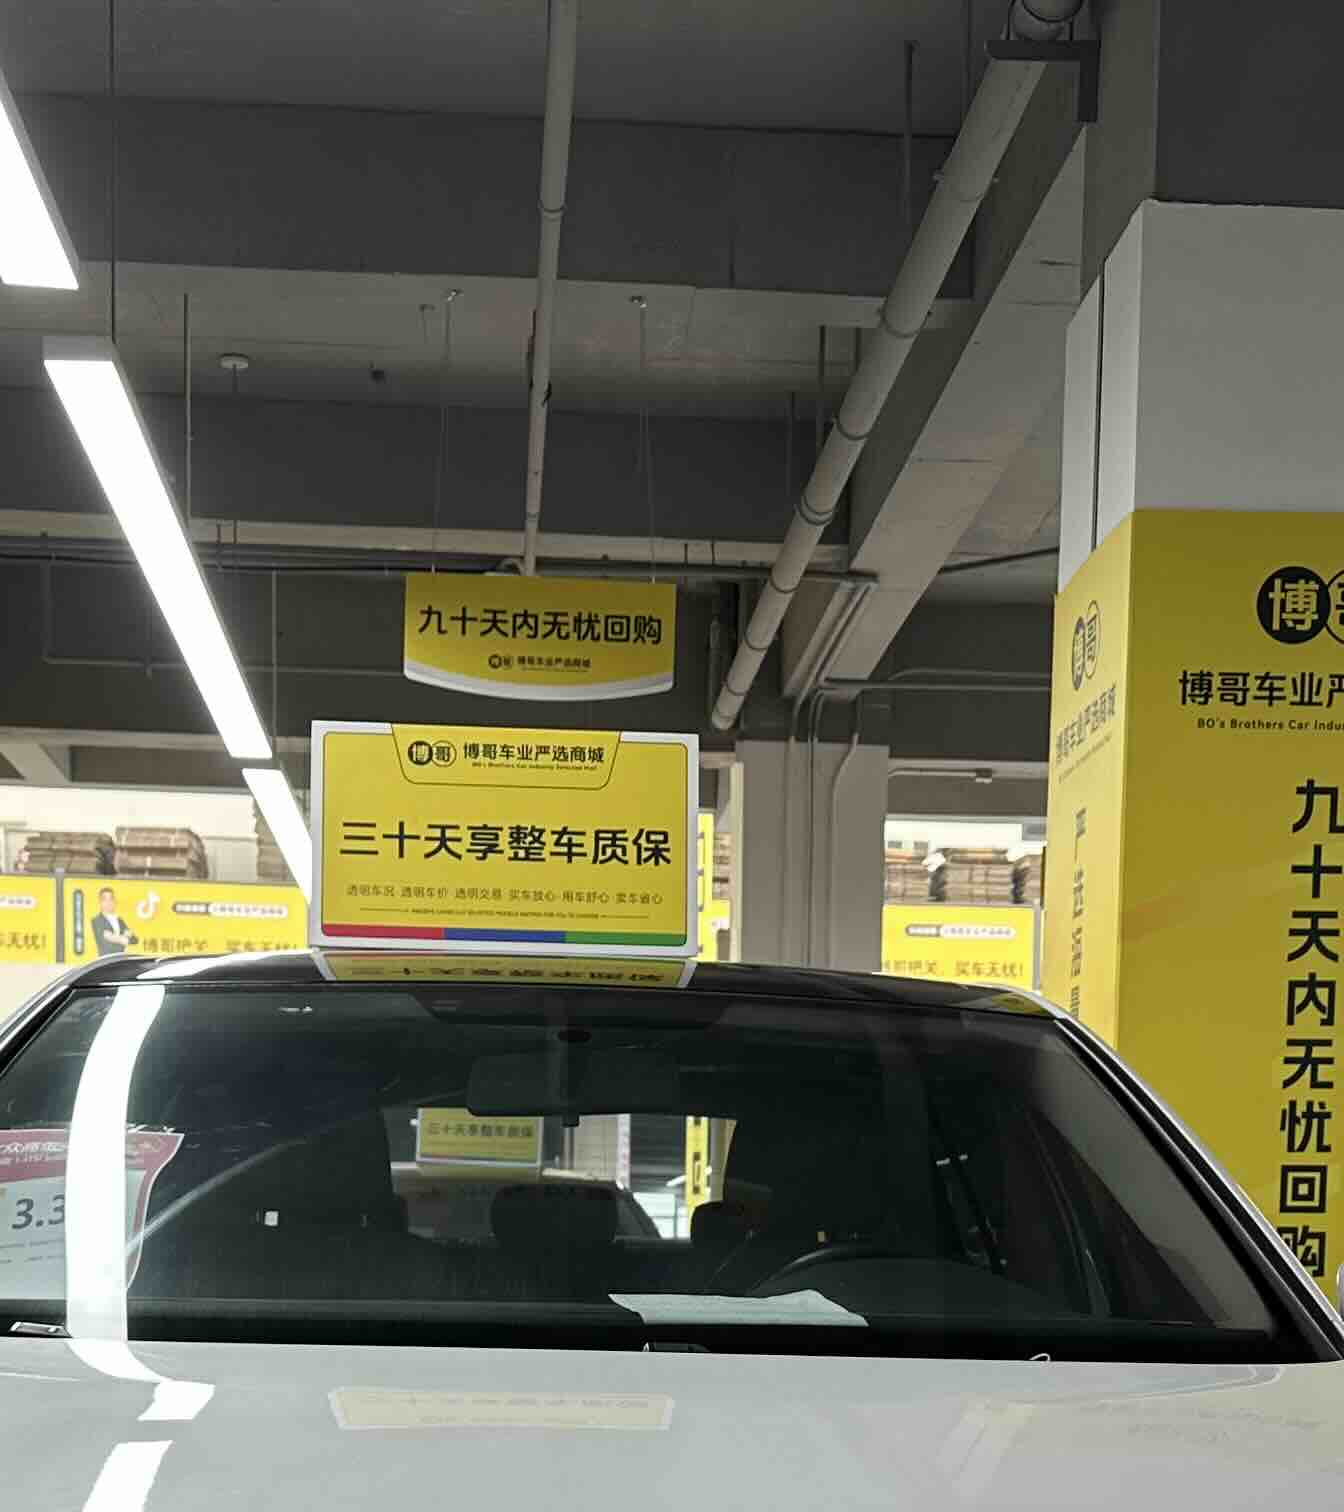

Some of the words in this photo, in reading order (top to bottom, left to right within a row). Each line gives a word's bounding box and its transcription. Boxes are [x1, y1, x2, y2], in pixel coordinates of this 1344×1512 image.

[418, 604, 662, 645] 九十天内无忧回购
[1230, 718, 1284, 730] Brothers
[1288, 719, 1309, 730] Car
[464, 742, 605, 763] 博哥车业严选商城
[339, 819, 672, 868] 三十天享整车质保
